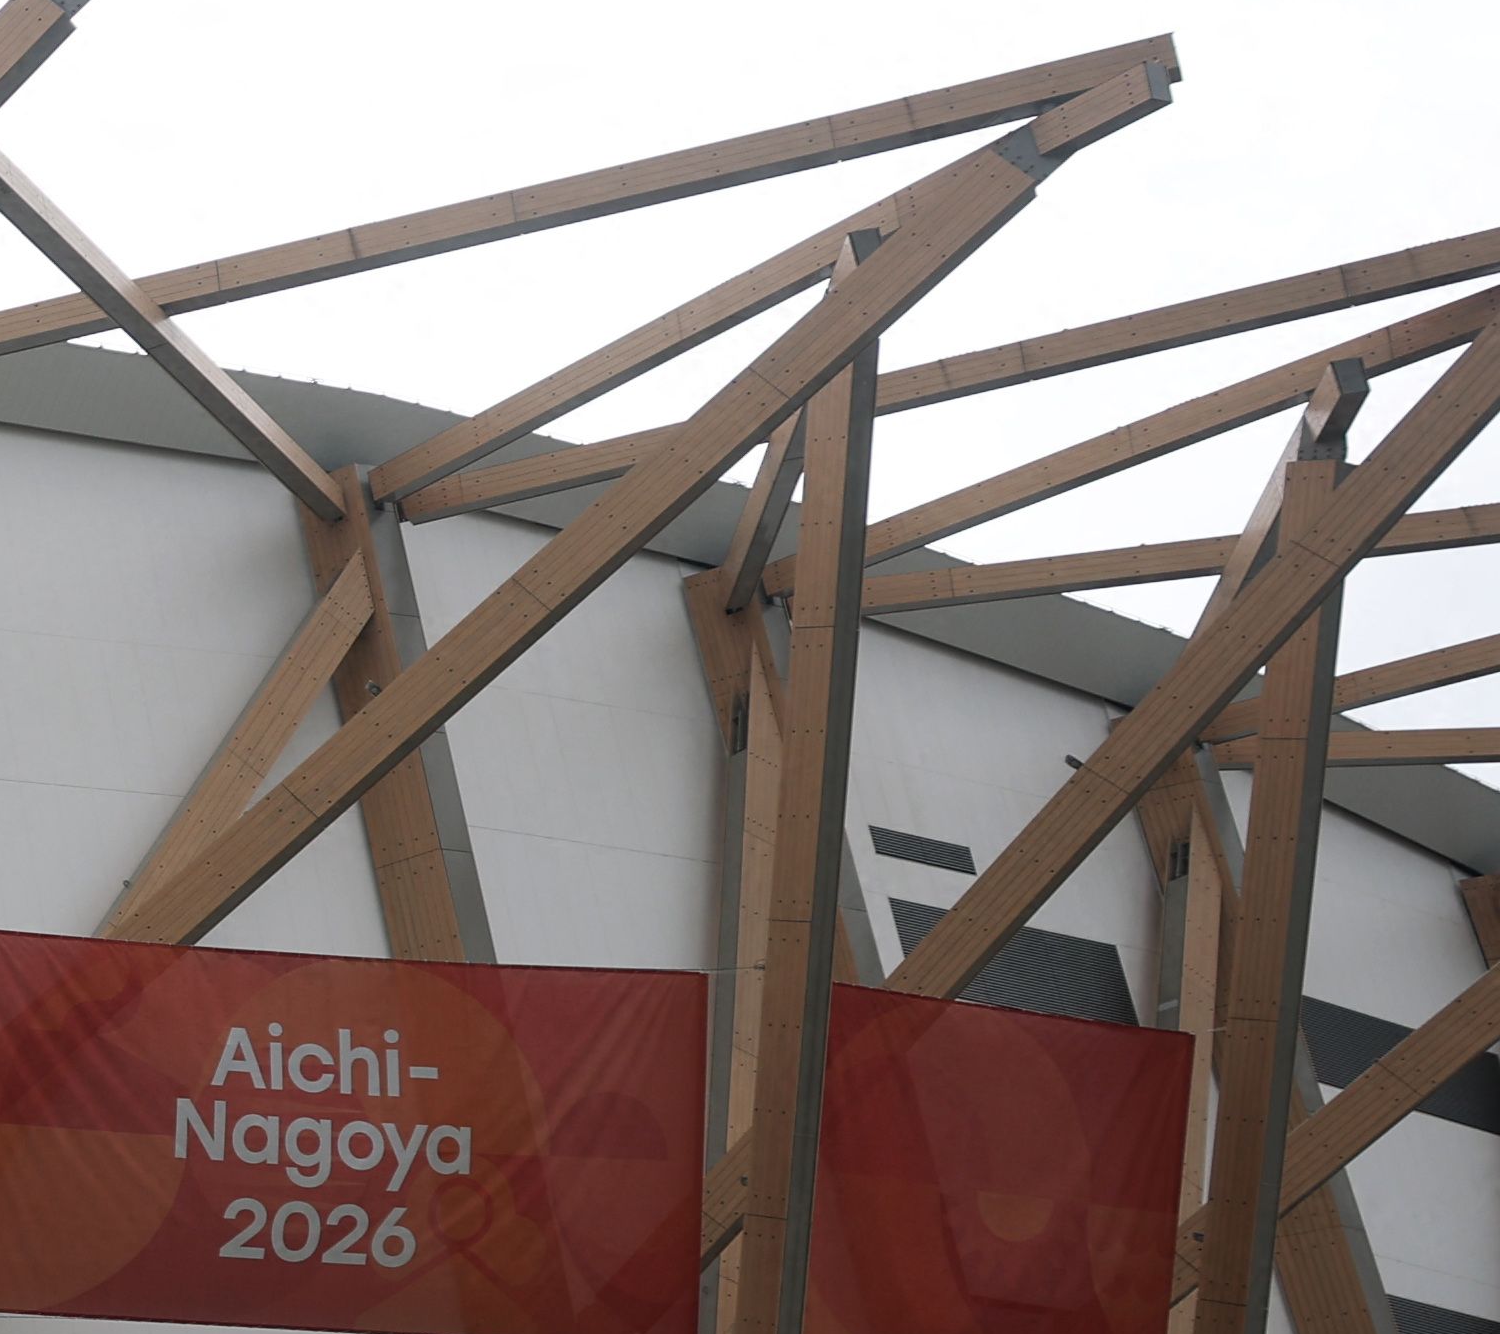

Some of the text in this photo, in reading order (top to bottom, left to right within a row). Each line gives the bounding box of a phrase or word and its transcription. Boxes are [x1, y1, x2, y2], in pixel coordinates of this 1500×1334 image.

[210, 1022, 439, 1097] Aichi-
[174, 1098, 471, 1193] Nagoya
[219, 1198, 416, 1268] 2026
